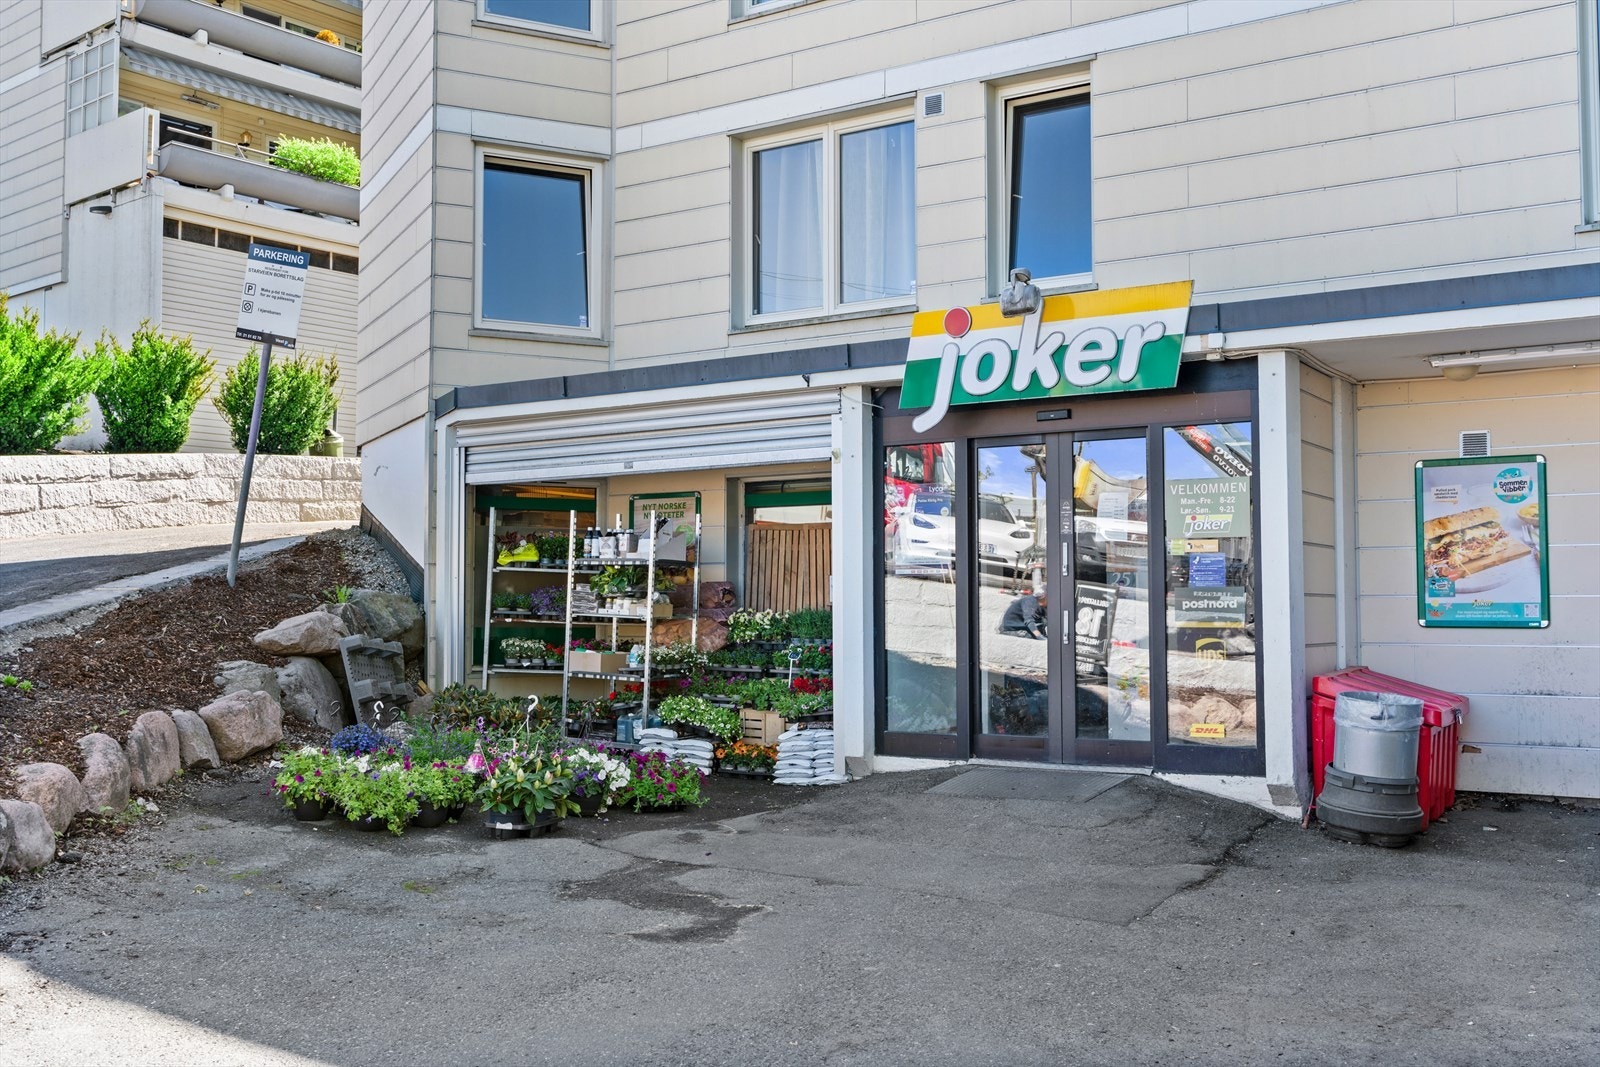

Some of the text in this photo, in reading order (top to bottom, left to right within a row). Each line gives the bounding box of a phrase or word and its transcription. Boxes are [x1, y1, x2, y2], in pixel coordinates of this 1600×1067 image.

[253, 248, 304, 264] PARKERING
[248, 268, 304, 282] STARVEIEN BORETTSLAG
[911, 298, 1166, 434] joker
[1170, 482, 1247, 495] VELKOMMEN
[658, 502, 687, 510] NORSKE
[1185, 515, 1229, 537] joker
[1182, 599, 1238, 610] postnord
